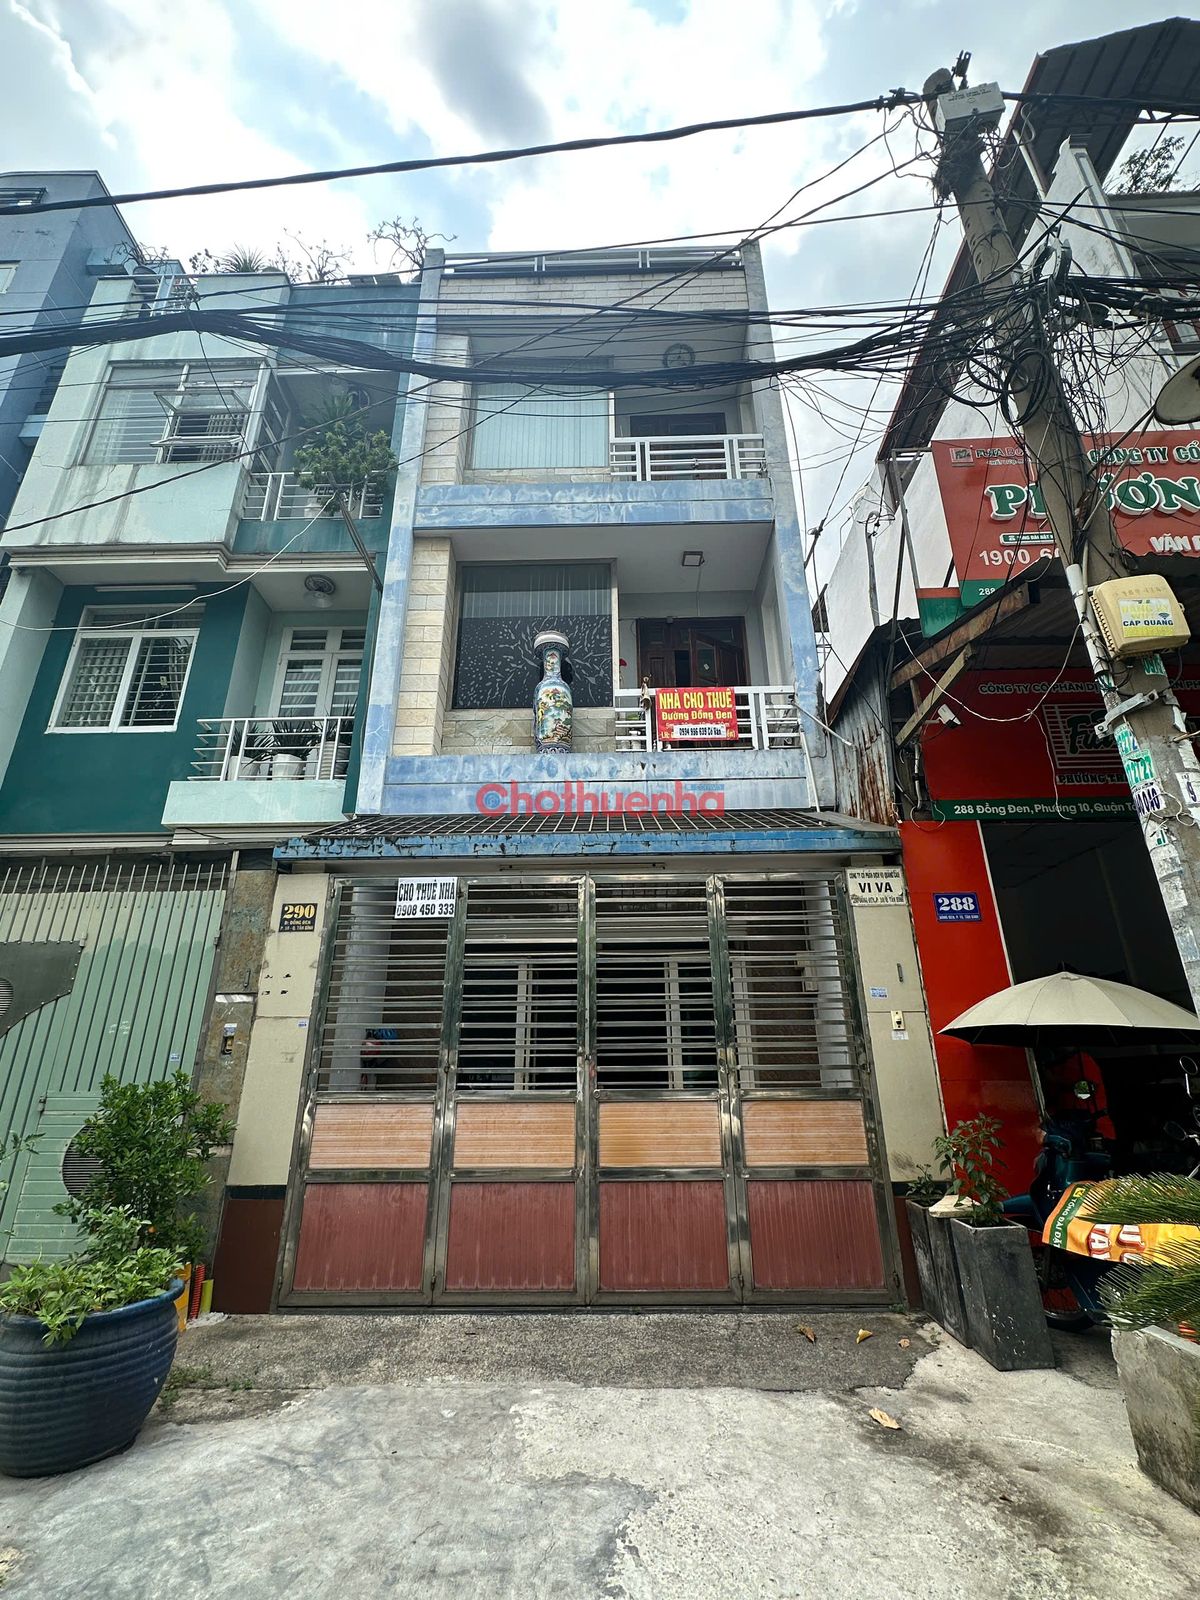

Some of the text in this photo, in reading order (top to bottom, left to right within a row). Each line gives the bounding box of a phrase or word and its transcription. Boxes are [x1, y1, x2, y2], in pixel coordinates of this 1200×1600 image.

[1088, 446, 1143, 464] CÔNG
[1144, 447, 1168, 464] TY
[1150, 534, 1191, 552] VĂN
[979, 549, 1031, 566] 1900
[979, 682, 1013, 694] CÔNG
[1014, 683, 1031, 693] TY
[659, 688, 733, 709] NHÀ CHO THUÊ
[716, 710, 732, 719] Đen
[954, 804, 974, 814] 288
[976, 802, 1006, 815] Đồng
[399, 883, 414, 901] CHO
[858, 882, 893, 893] VI VA
[397, 903, 454, 916] 0908 450 333
[938, 896, 976, 911] 288
[283, 904, 315, 919] 290
